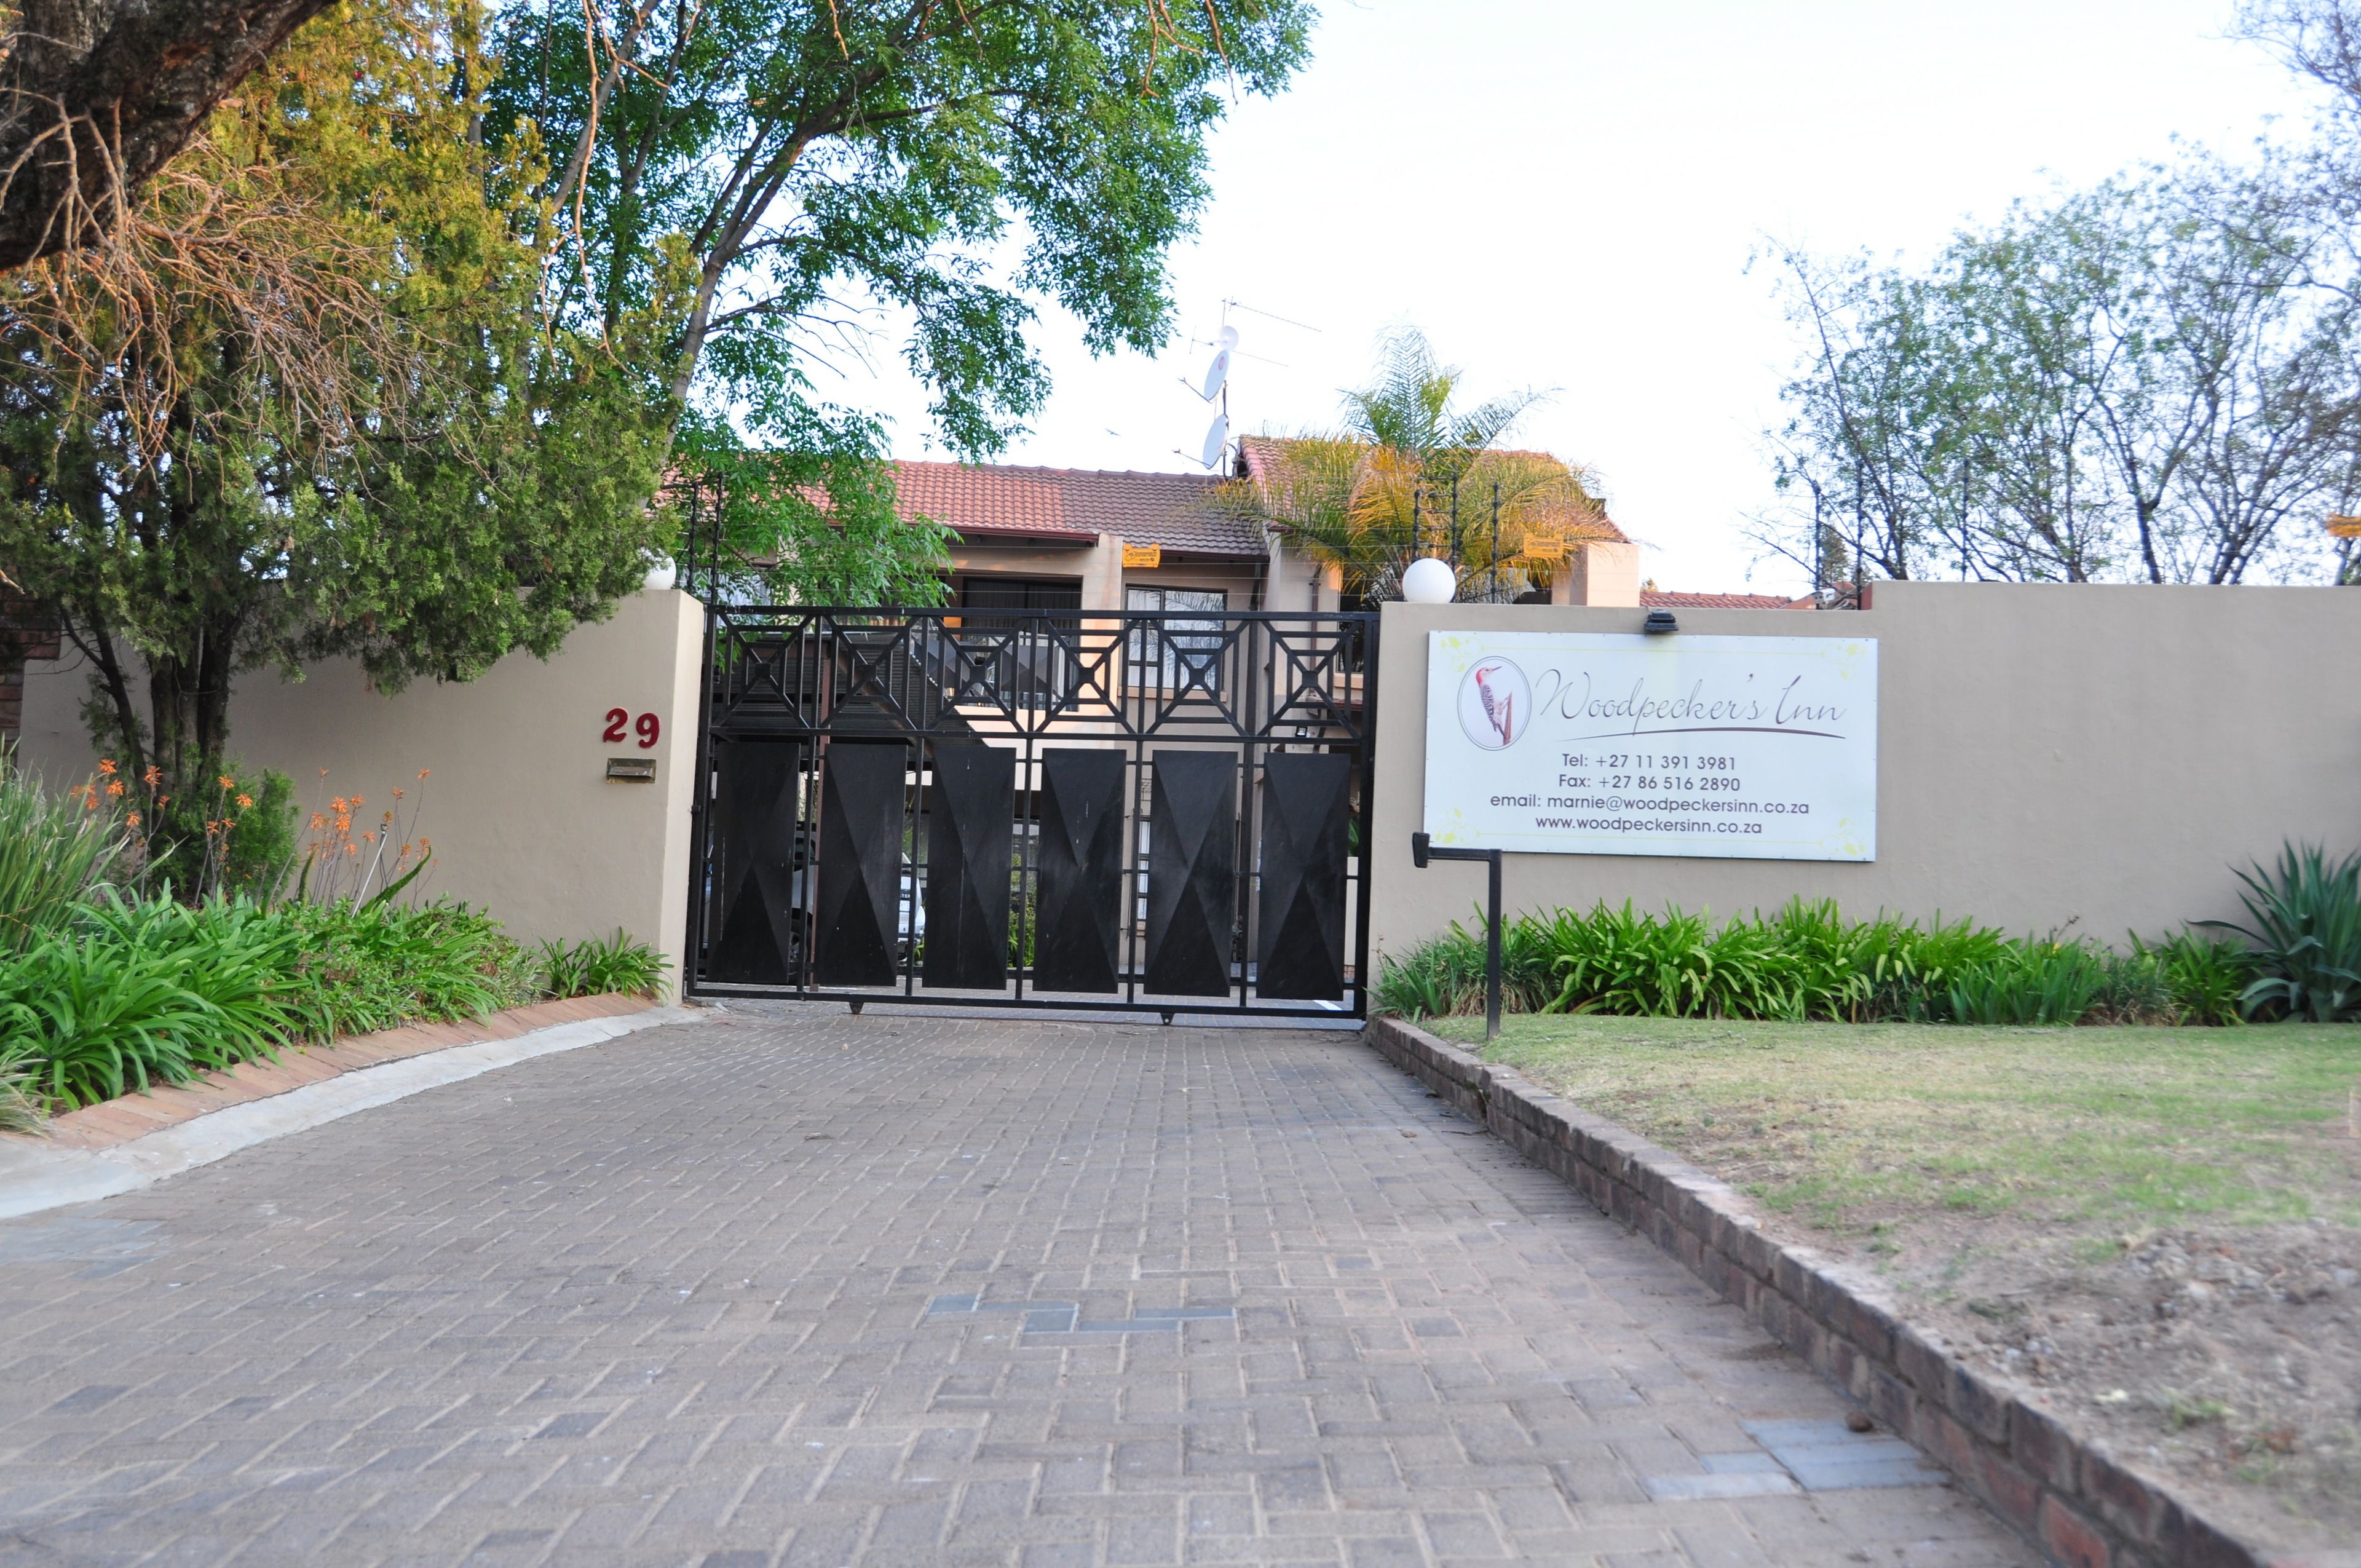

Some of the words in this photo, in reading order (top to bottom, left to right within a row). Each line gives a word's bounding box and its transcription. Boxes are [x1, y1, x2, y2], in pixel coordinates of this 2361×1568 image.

[1535, 668, 1768, 736] Woodpecker's
[1774, 675, 1847, 725] Inn
[603, 708, 660, 748] 29
[1562, 753, 1588, 767] Tel:
[1596, 754, 1628, 767] +27
[1637, 755, 1651, 768] 11
[1661, 756, 1688, 769] 391
[1697, 756, 1734, 770] 3981
[1559, 774, 1591, 788] Fax:
[1599, 775, 1631, 788] +27
[1638, 775, 1657, 789] 86
[1664, 777, 1693, 790] 516
[1700, 777, 1740, 791] 2890
[1490, 794, 1541, 807] email:
[1548, 796, 1809, 814] marnie@woodpeckersinn.co.za
[1535, 817, 1762, 834] www.woodpeckersinn.co.za
